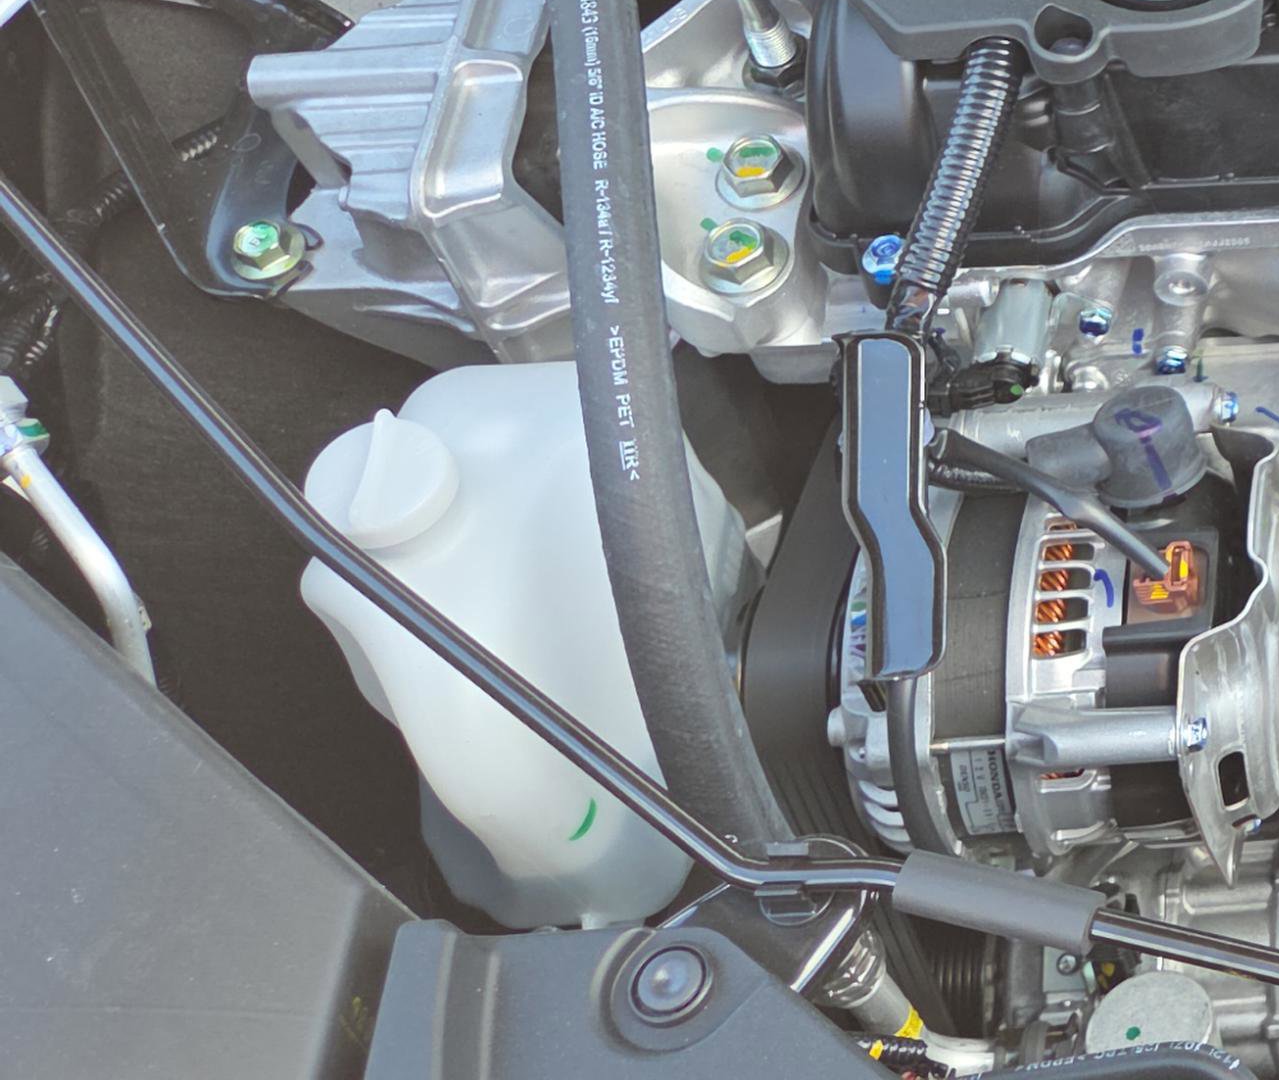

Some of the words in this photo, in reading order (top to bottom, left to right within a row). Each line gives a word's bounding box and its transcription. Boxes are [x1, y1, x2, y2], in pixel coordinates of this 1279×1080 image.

[581, 25, 601, 67] (16mm)
[589, 107, 606, 129] A/C
[590, 131, 608, 169] HOSE
[594, 179, 611, 228] R-134a
[597, 239, 618, 303] R-1234yf
[614, 393, 635, 429] PET
